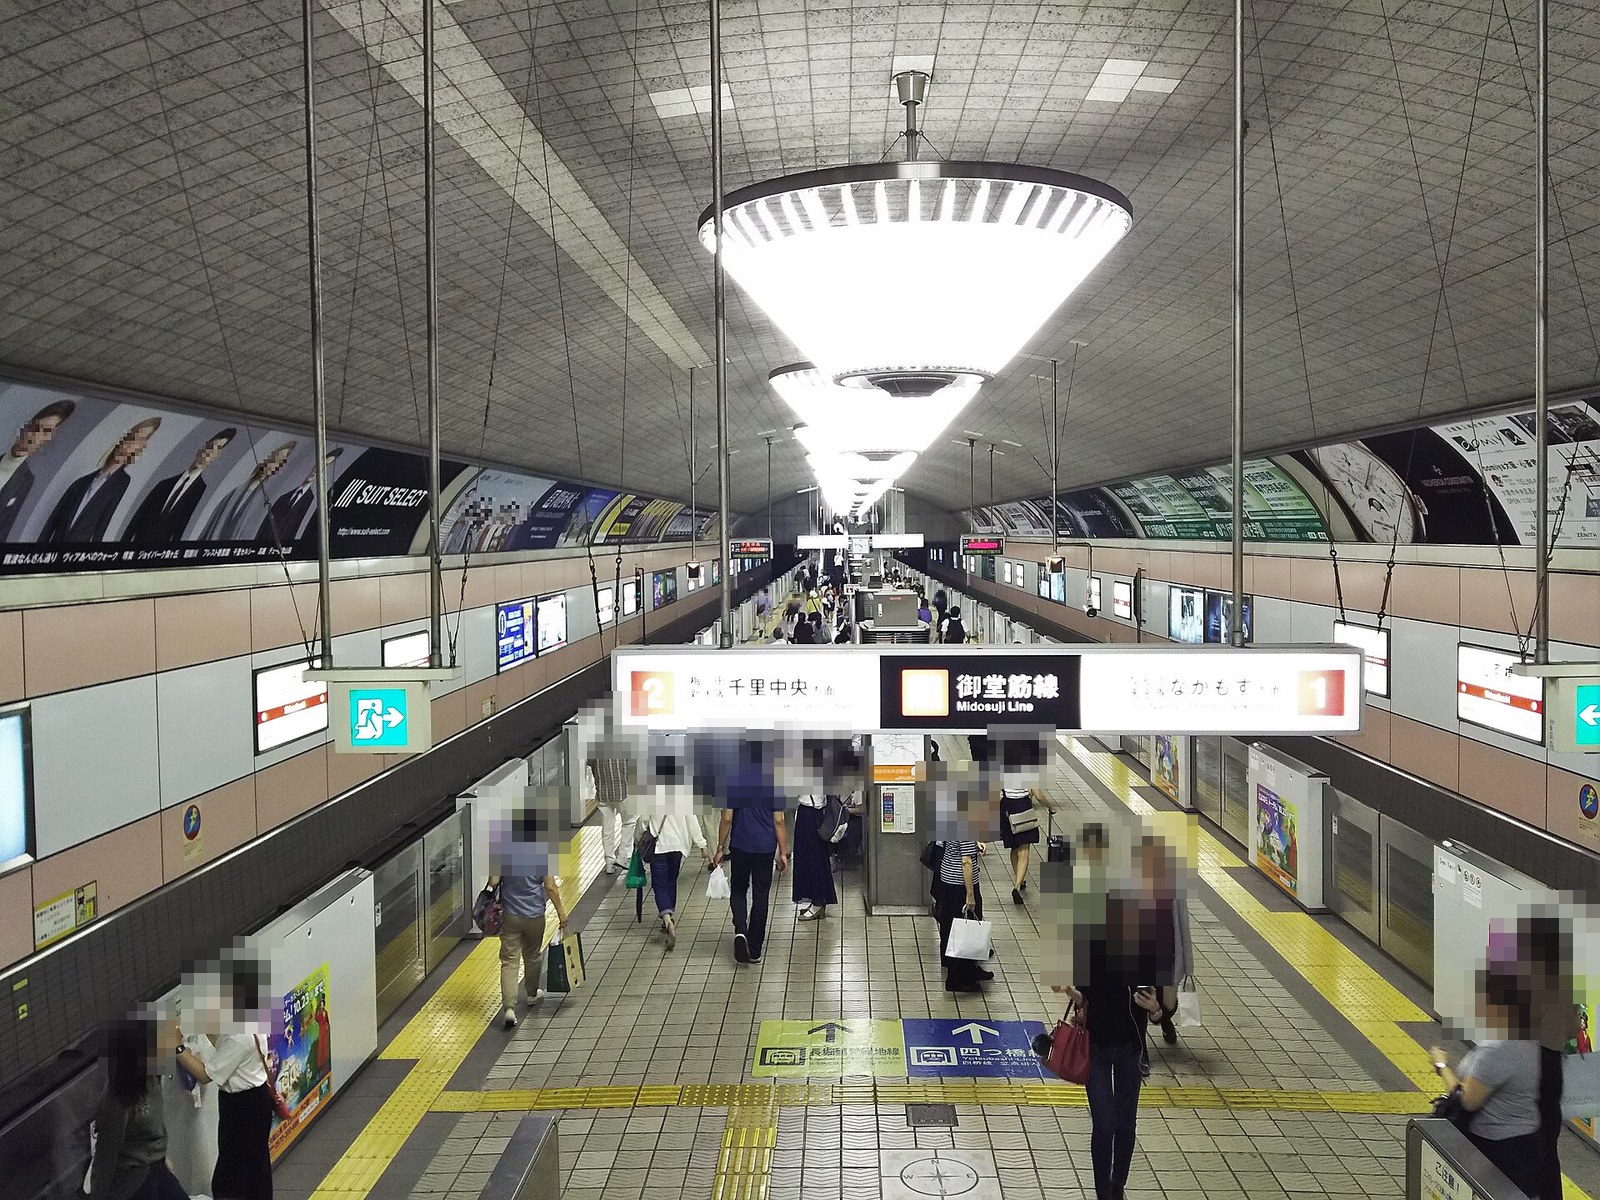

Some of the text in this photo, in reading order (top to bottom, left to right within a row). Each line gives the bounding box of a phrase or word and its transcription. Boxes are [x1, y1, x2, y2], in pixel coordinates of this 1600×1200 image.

[356, 484, 428, 507] SUIT SELECT
[642, 677, 666, 709] 2
[728, 678, 808, 696] 千里中央
[956, 673, 1060, 699] 御堂筋線
[1310, 676, 1327, 709] 1
[956, 701, 1034, 714] Midosuji Line
